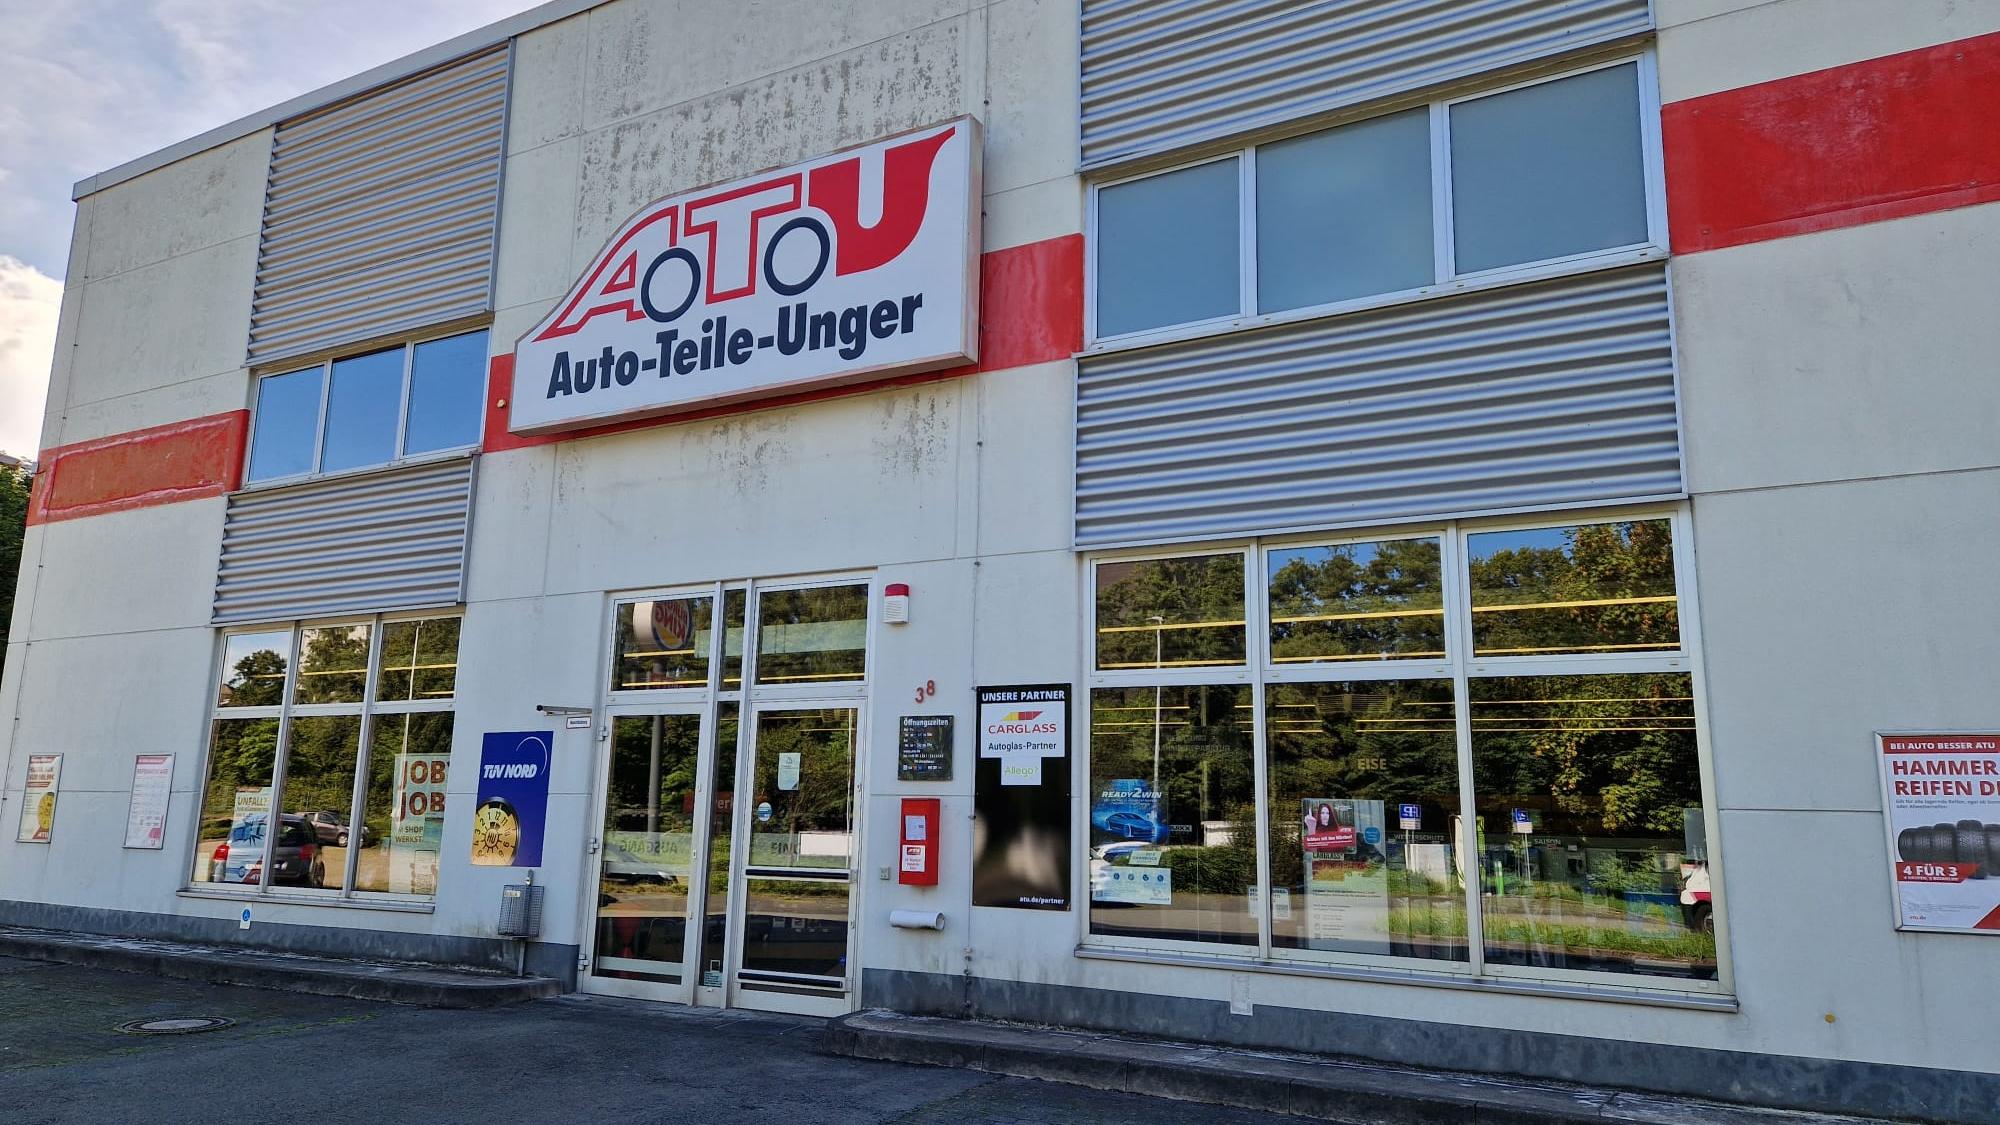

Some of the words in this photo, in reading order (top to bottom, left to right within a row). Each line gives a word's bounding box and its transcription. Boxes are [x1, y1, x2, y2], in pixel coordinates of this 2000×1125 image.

[546, 293, 923, 399] Auto-Teile-Unger
[915, 680, 935, 704] 38
[982, 692, 1018, 702] UNSERE
[1020, 690, 1065, 700] PARTNER
[988, 723, 1057, 734] CARGLASS
[988, 741, 1057, 752] Autoglas-Partner
[1937, 742, 1973, 750] BESSER
[483, 764, 506, 779] TÜV
[504, 764, 538, 779] NORD
[1892, 760, 1999, 776] HAMMER
[1101, 787, 1162, 799] READY2WIN
[1894, 780, 1973, 796] REIFEN
[1903, 865, 1912, 875] 4
[1916, 863, 1946, 877] FÜR
[1948, 866, 1958, 877] 3
